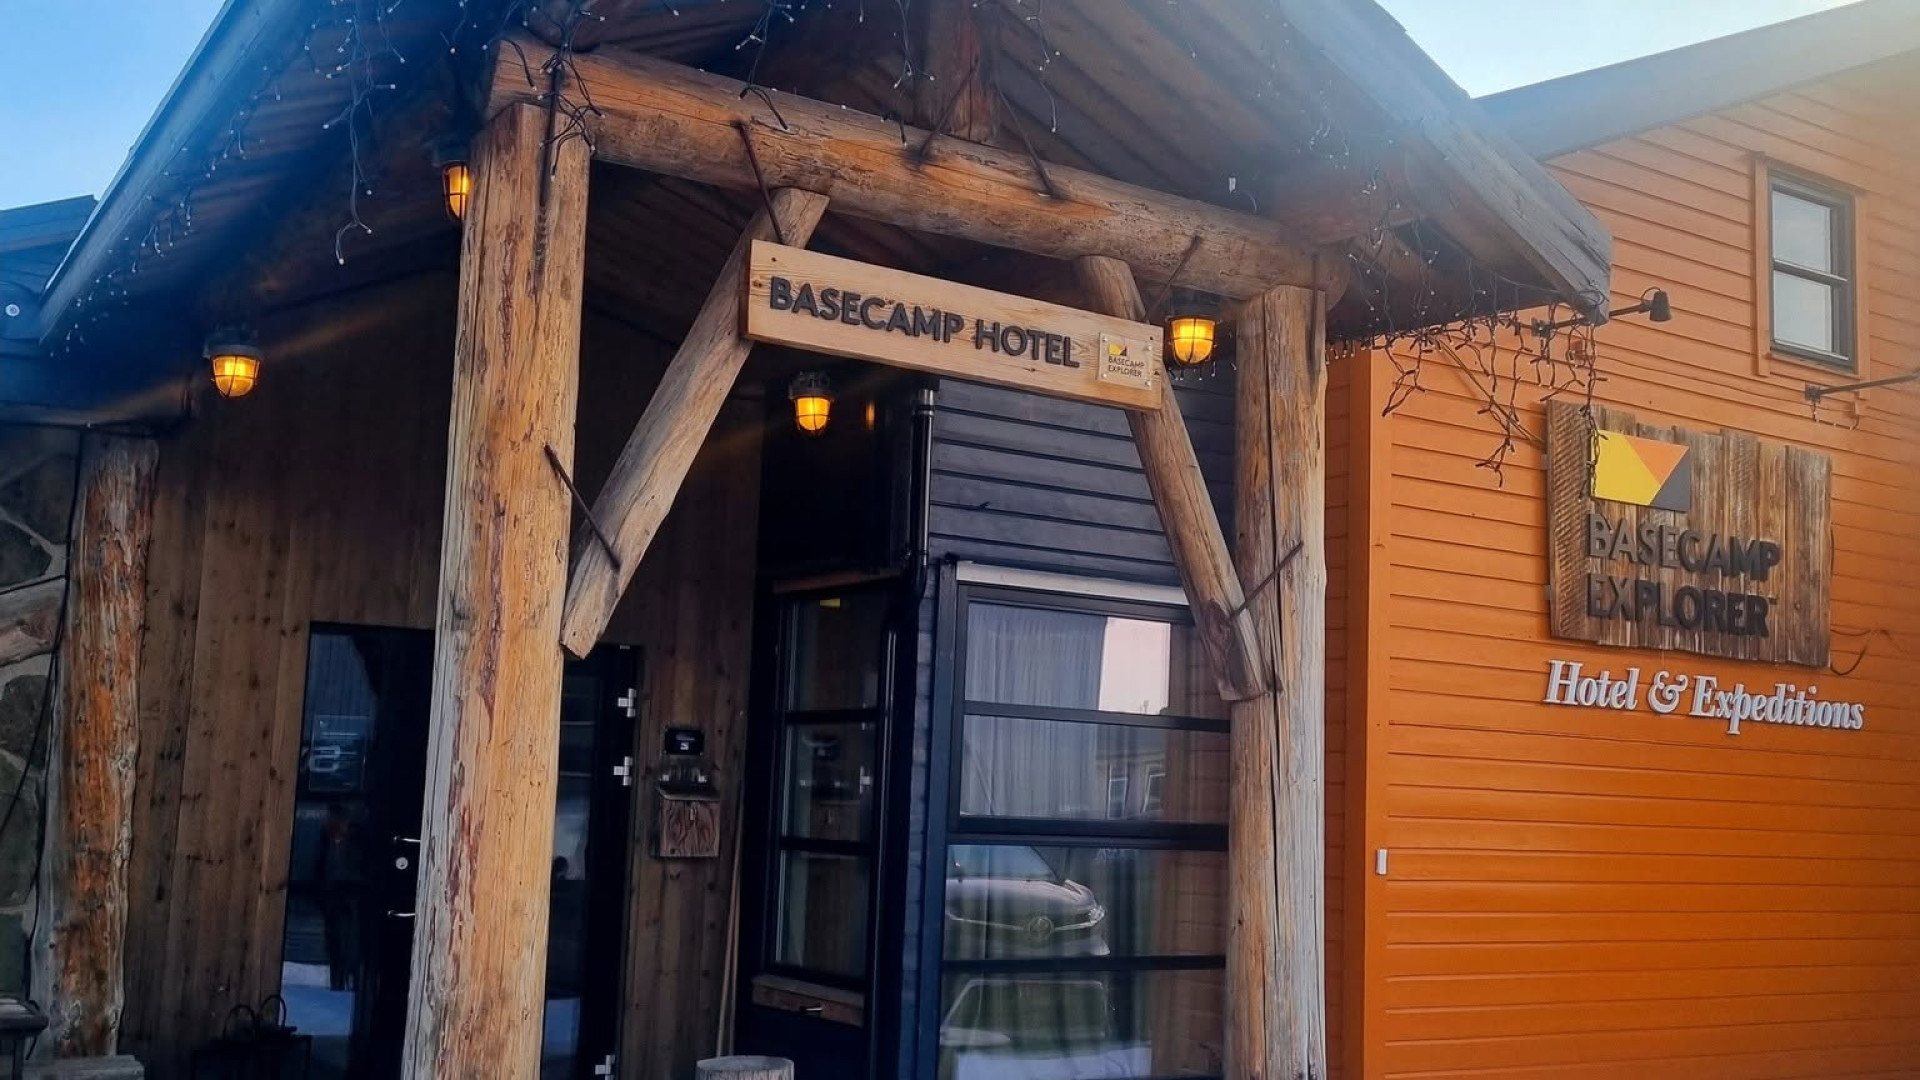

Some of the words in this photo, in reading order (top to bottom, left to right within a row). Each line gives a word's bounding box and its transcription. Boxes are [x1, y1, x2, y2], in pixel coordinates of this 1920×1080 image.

[770, 276, 964, 343] BASECAMP
[975, 319, 1080, 368] HOTEL
[1108, 356, 1145, 367] BASECAMP
[1108, 365, 1142, 377] EXPLORER
[1587, 514, 1780, 581] BASECAMP
[1587, 573, 1770, 637] EXPLORER
[1544, 659, 1641, 711] Hotel
[1648, 670, 1688, 714] &
[1690, 674, 1865, 735] Expeditions
